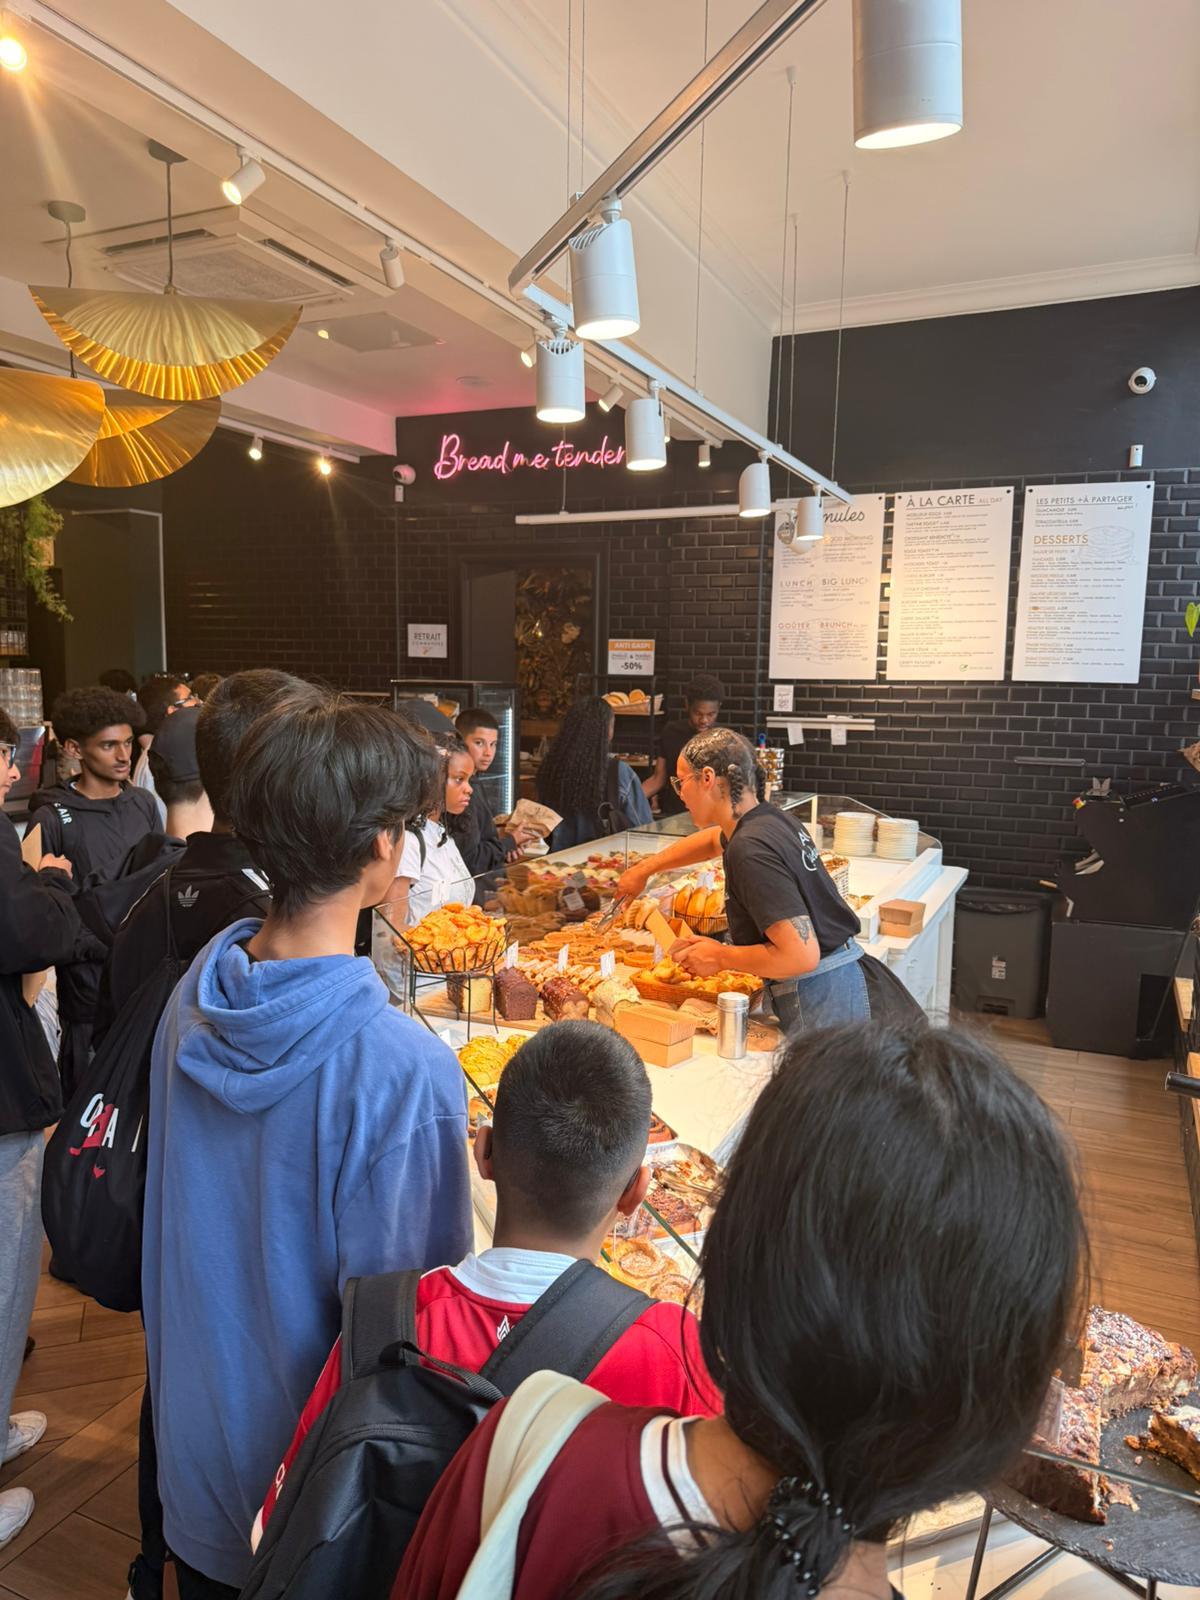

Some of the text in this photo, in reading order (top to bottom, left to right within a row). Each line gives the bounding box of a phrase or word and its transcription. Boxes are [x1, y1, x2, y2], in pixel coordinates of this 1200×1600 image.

[434, 434, 627, 480] Bread me tender
[906, 494, 915, 507] À
[919, 497, 933, 507] LA
[937, 494, 975, 506] CARTE
[1036, 497, 1048, 505] LES
[1091, 495, 1133, 503] PARTAGER
[1033, 534, 1089, 545] DESSERTS
[779, 579, 814, 588] LUNCH
[821, 578, 838, 586] BIG
[413, 632, 441, 641] RETRAIT
[620, 661, 642, 671] -50%
[57, 808, 73, 825] AIR
